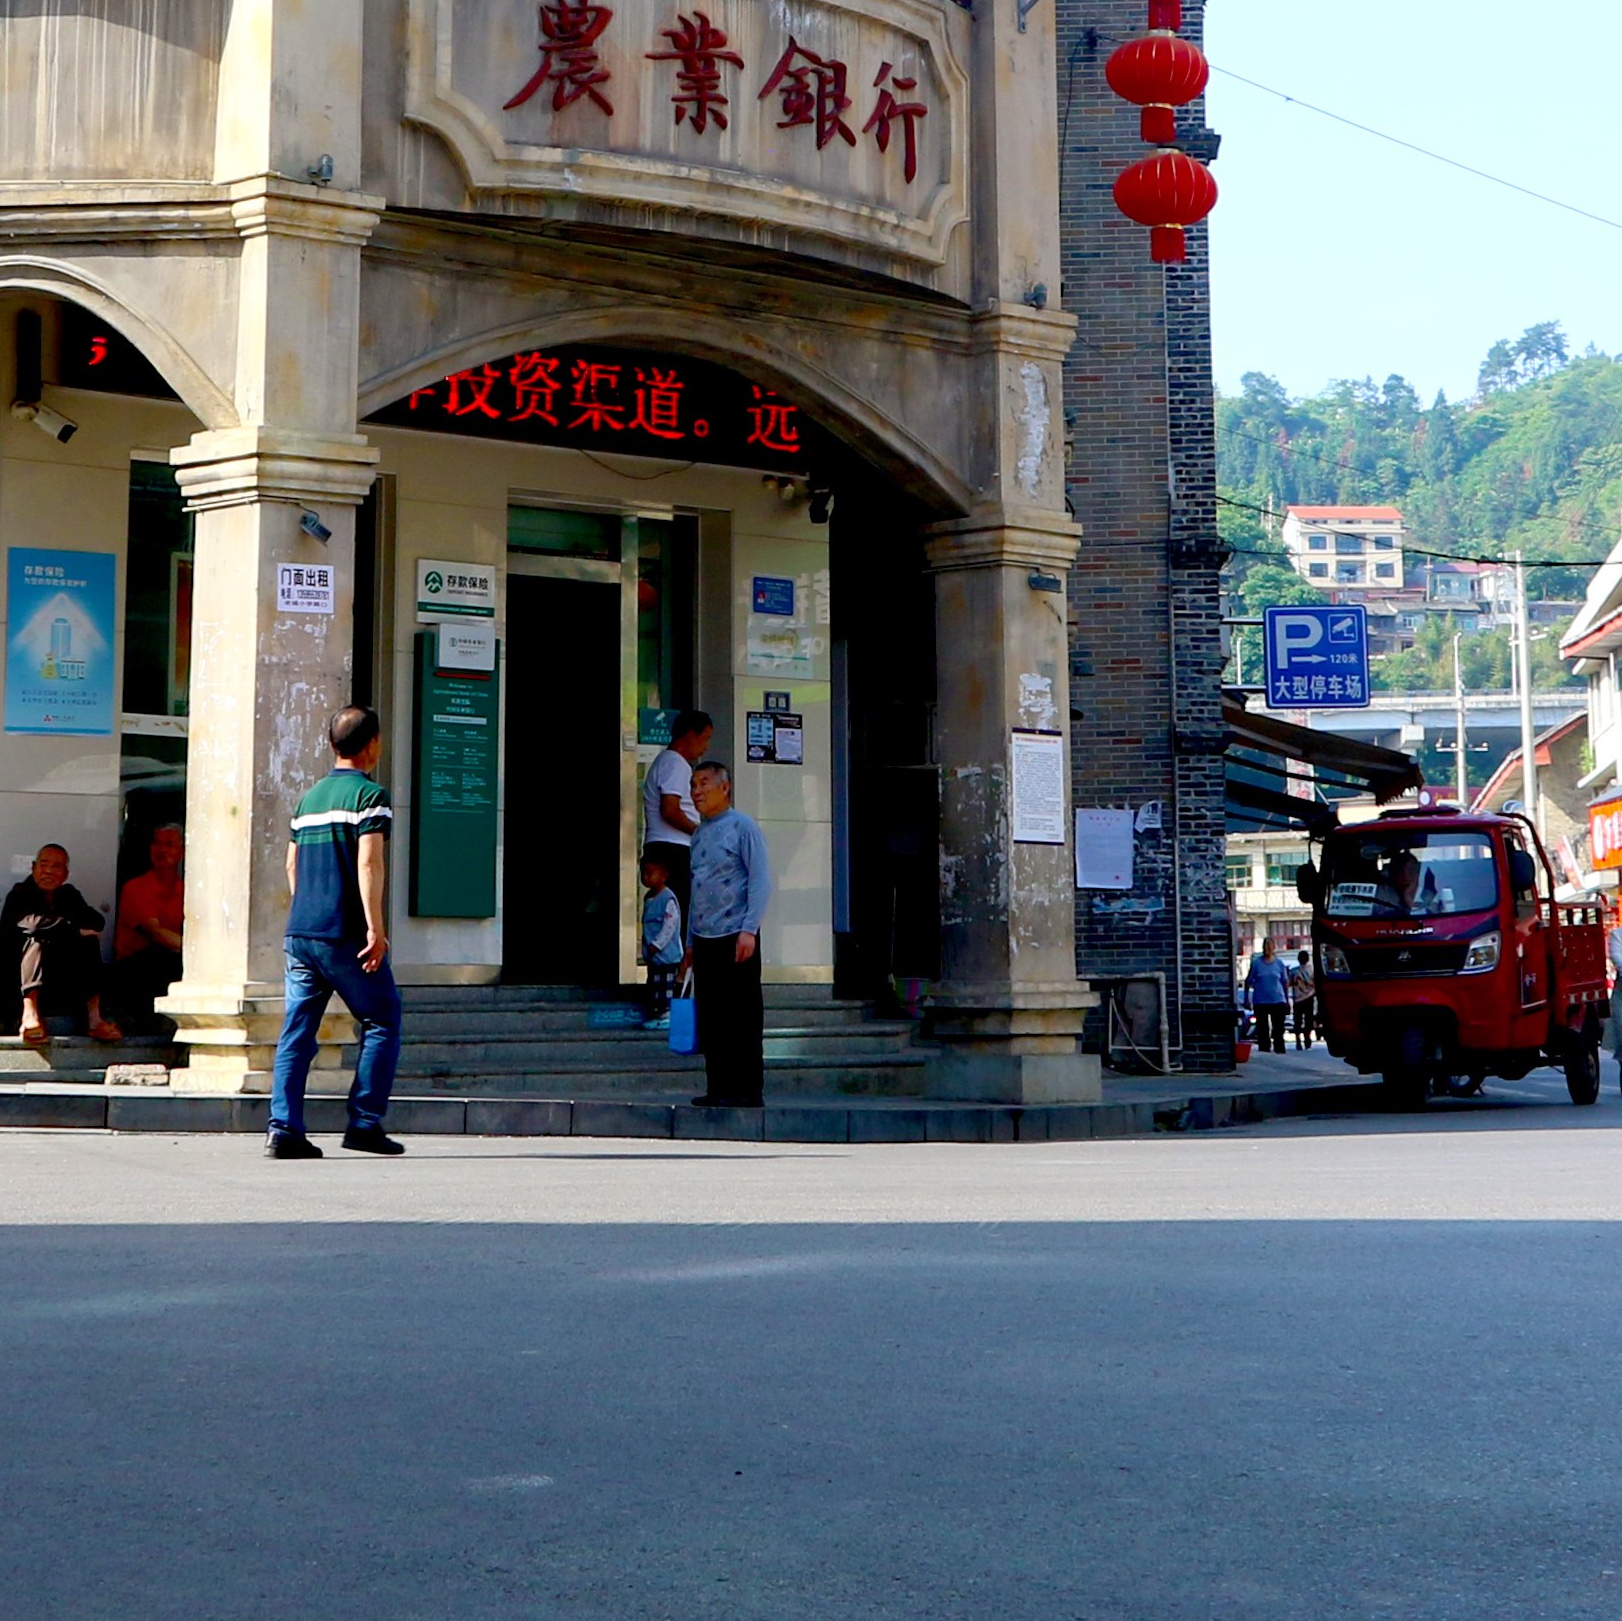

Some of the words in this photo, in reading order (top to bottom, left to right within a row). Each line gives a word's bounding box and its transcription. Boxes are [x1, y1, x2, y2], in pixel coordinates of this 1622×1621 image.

[24, 565, 64, 578] 存款保险
[281, 568, 329, 588] 门面出租
[447, 575, 489, 590] 存款保险
[1274, 614, 1323, 669] P
[1329, 653, 1359, 664] 120米
[1274, 675, 1362, 700] 大型停车场
